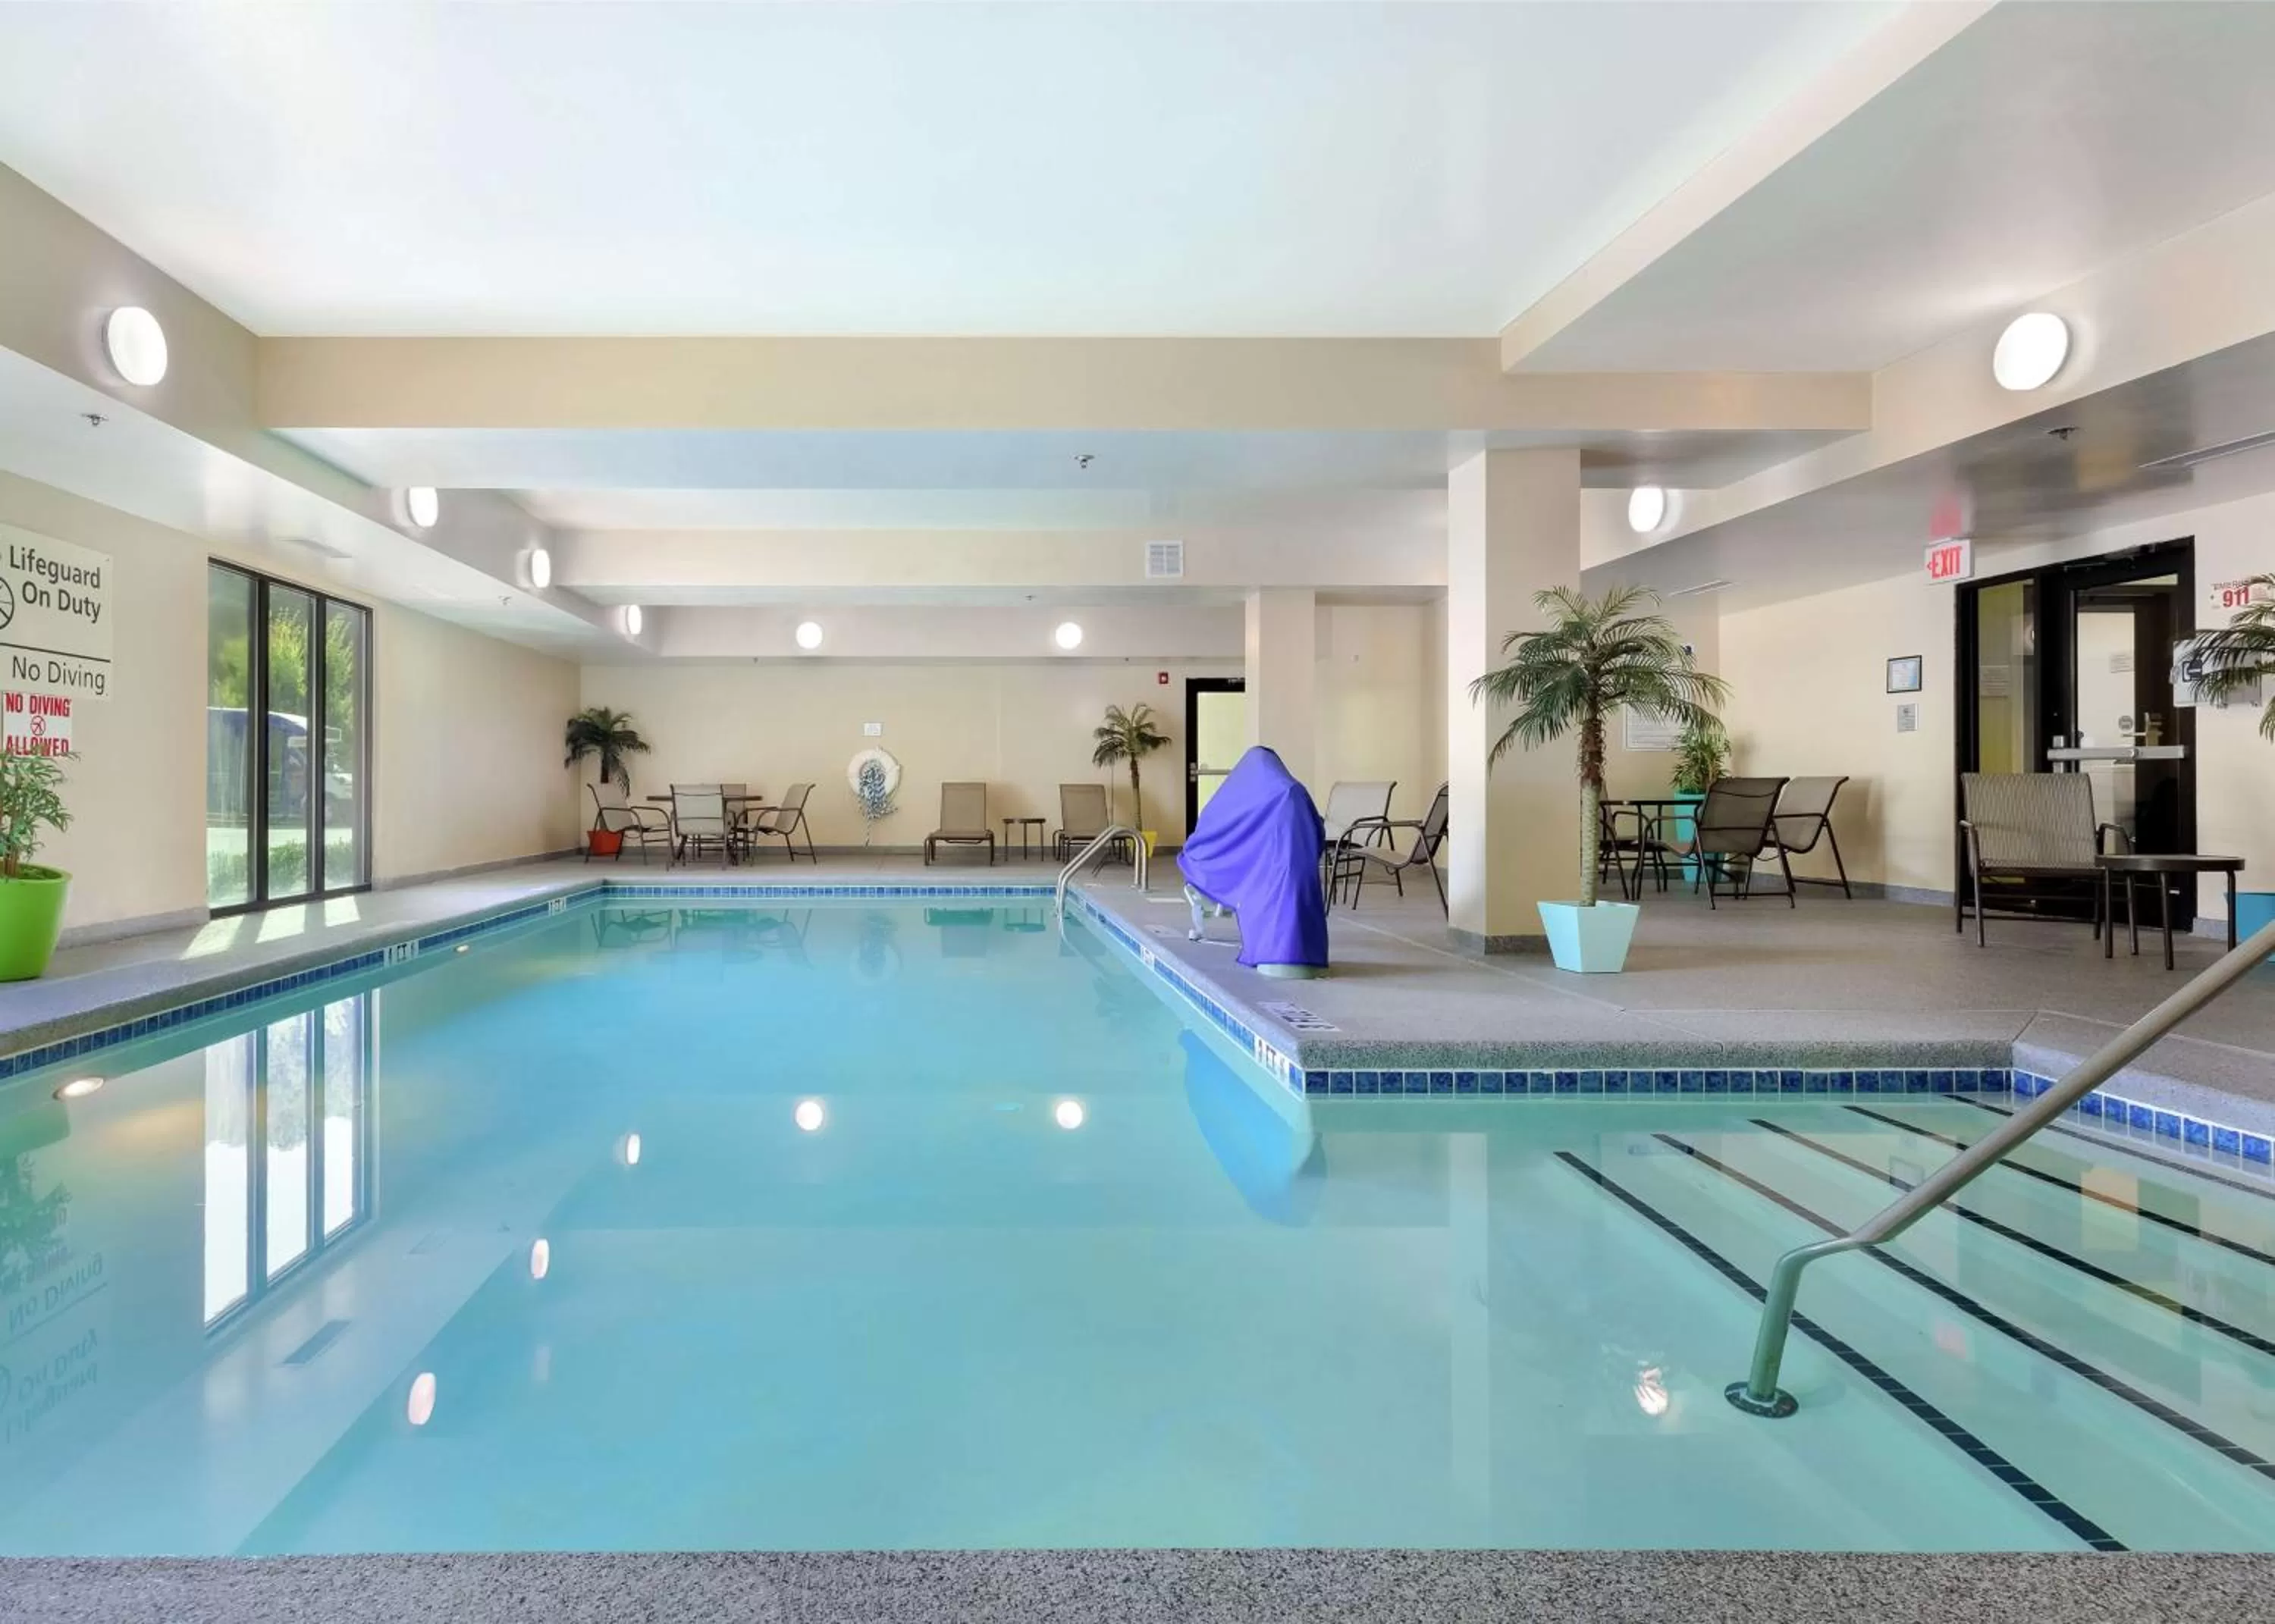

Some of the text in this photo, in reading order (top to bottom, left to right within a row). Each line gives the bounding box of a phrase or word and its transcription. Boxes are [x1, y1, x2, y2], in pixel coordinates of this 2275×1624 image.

[10, 545, 100, 588] Lifeguard
[1931, 545, 1962, 578] EXIT
[22, 581, 101, 623] On Duty
[2223, 586, 2249, 607] 911
[12, 655, 105, 694] No Diving
[6, 692, 71, 717] NO DIVING
[6, 735, 69, 757] ALLOWED
